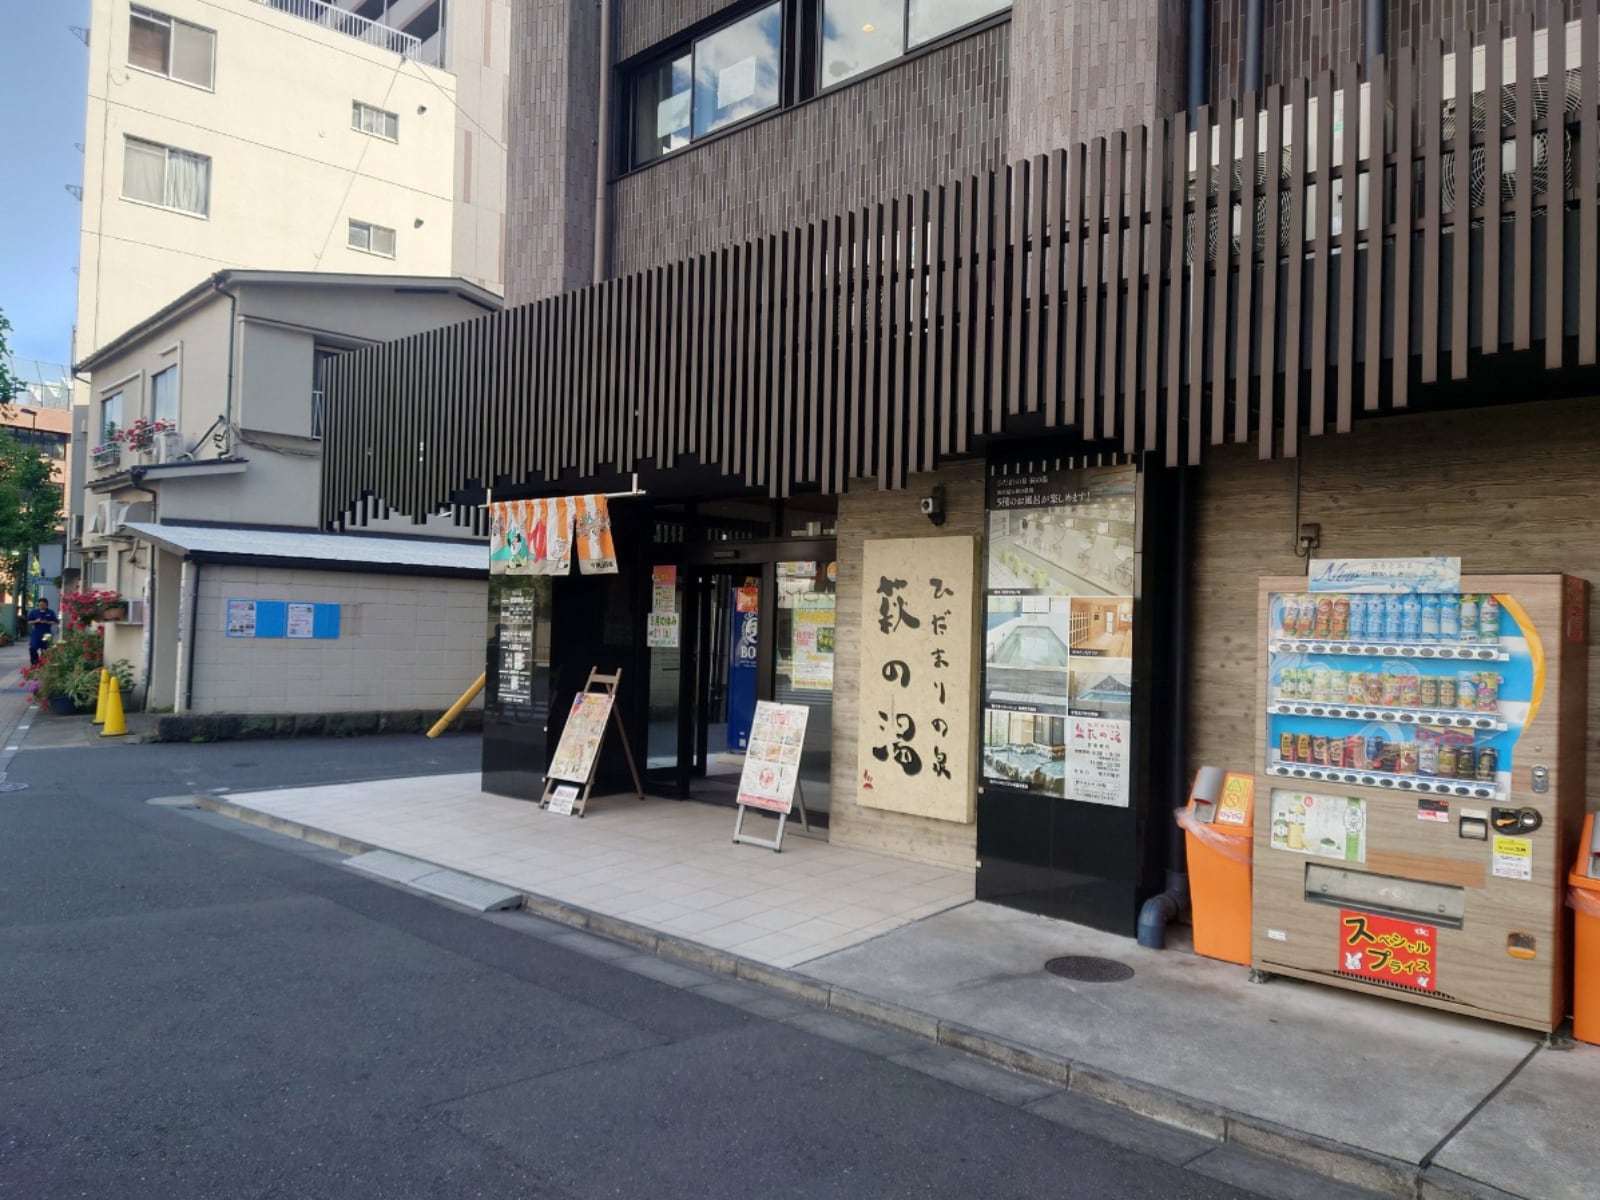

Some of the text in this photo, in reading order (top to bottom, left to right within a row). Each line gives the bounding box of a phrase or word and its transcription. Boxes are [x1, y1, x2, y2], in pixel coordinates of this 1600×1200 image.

[1312, 562, 1361, 583] New
[929, 577, 954, 780] ひだまりの泉
[1344, 916, 1431, 954] スペシャル
[1366, 948, 1431, 976] プライス
